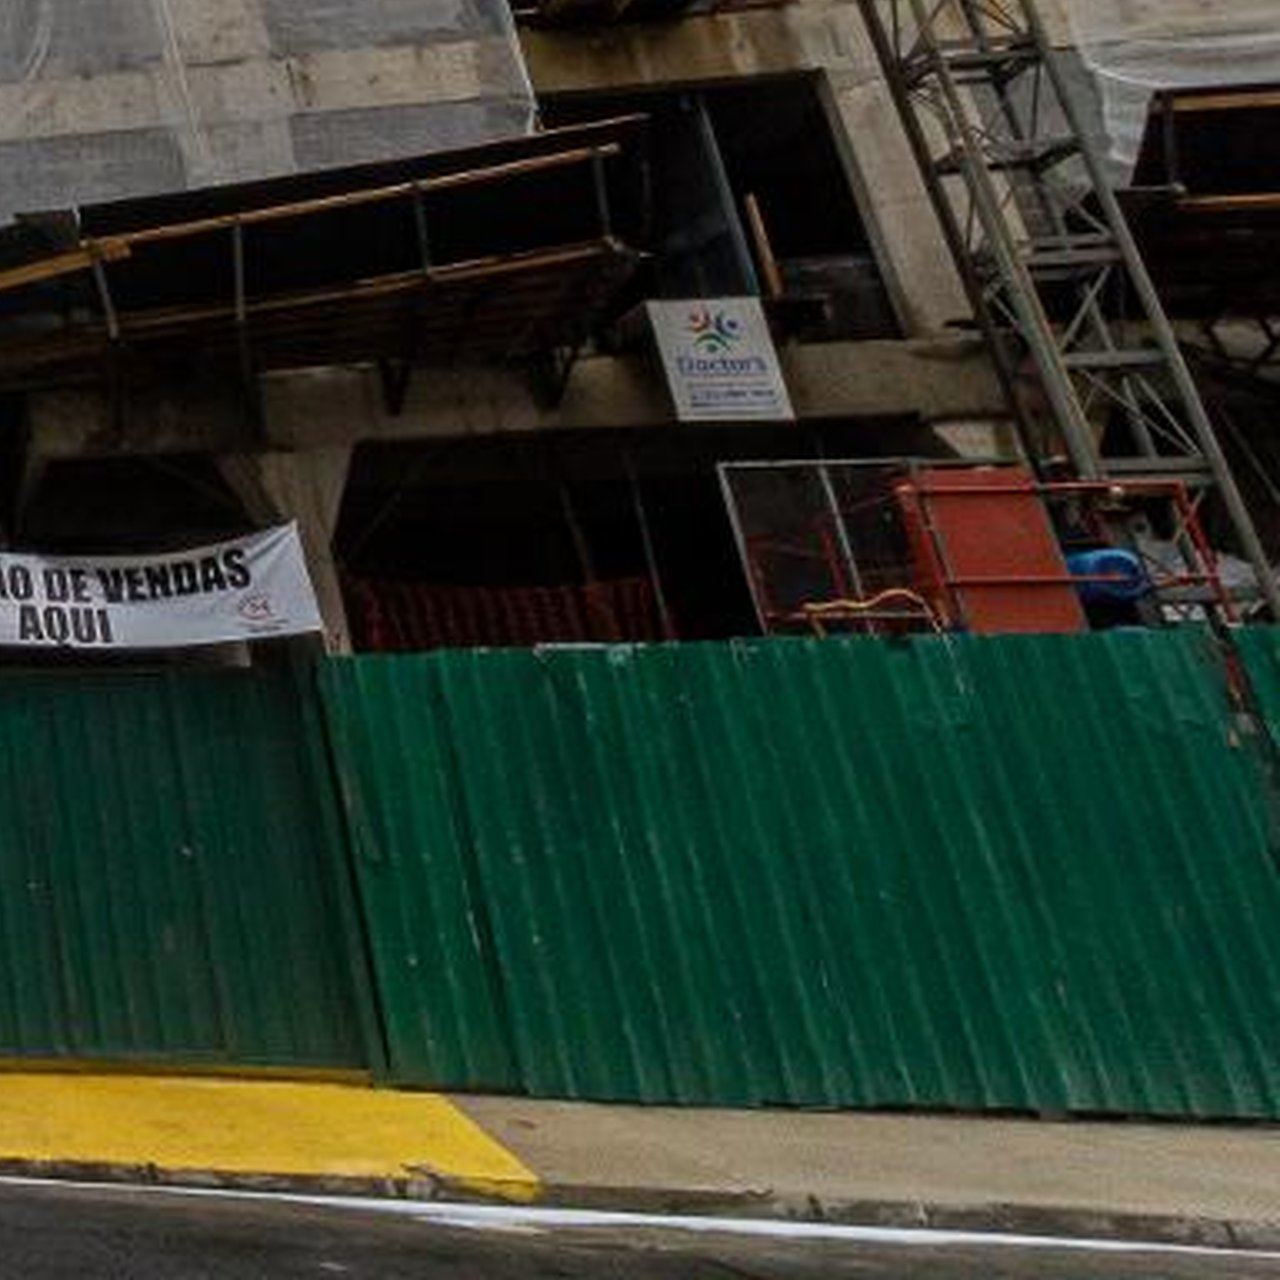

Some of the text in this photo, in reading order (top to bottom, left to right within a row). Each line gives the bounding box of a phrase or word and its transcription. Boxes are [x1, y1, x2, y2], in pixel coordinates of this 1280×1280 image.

[42, 568, 93, 602] DE
[95, 549, 251, 603] VENDAS
[19, 605, 113, 643] AQUI
